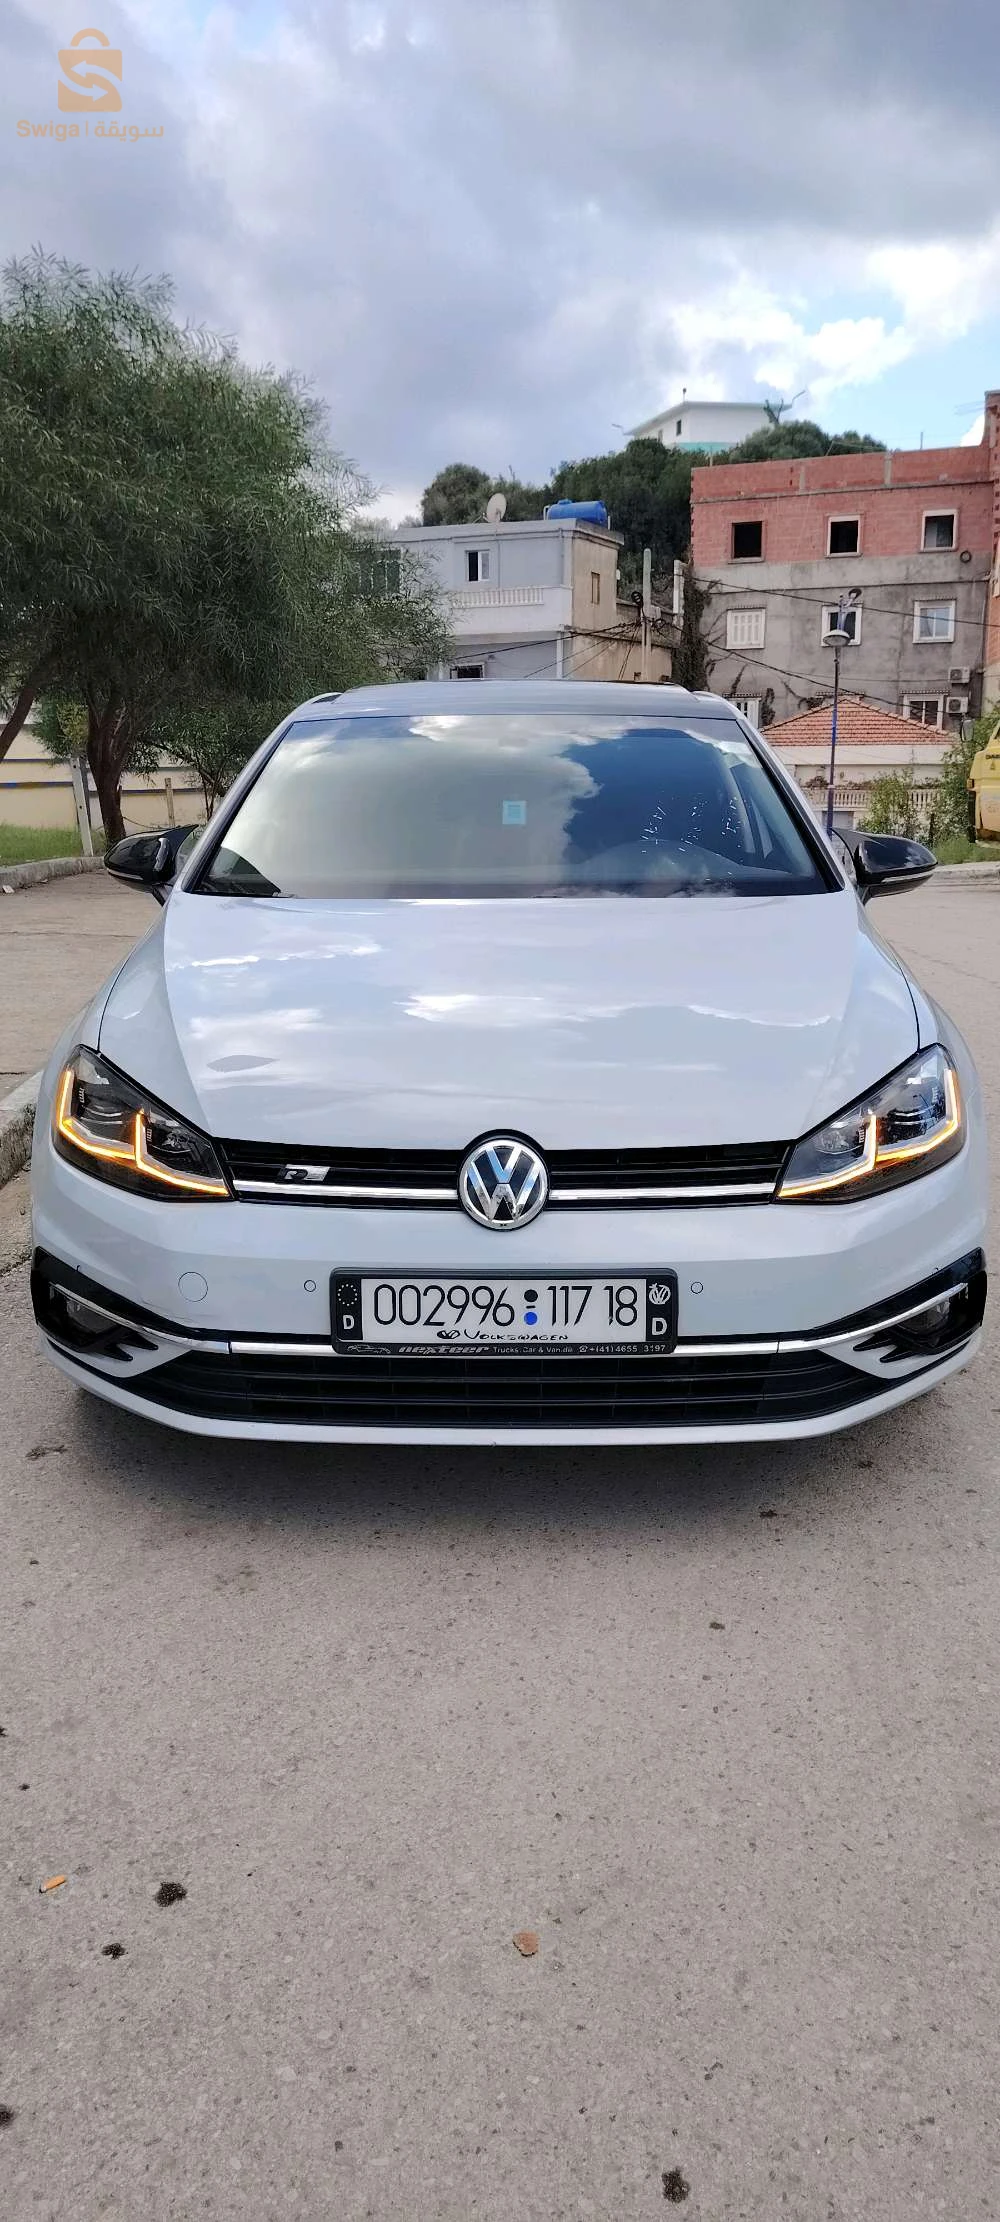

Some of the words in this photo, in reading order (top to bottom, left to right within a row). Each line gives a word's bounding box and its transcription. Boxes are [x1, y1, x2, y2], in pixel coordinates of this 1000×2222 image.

[373, 1283, 515, 1327] 002996
[547, 1284, 593, 1327] 117
[603, 1284, 638, 1327] 18
[342, 1314, 354, 1330] D
[651, 1317, 668, 1336] D
